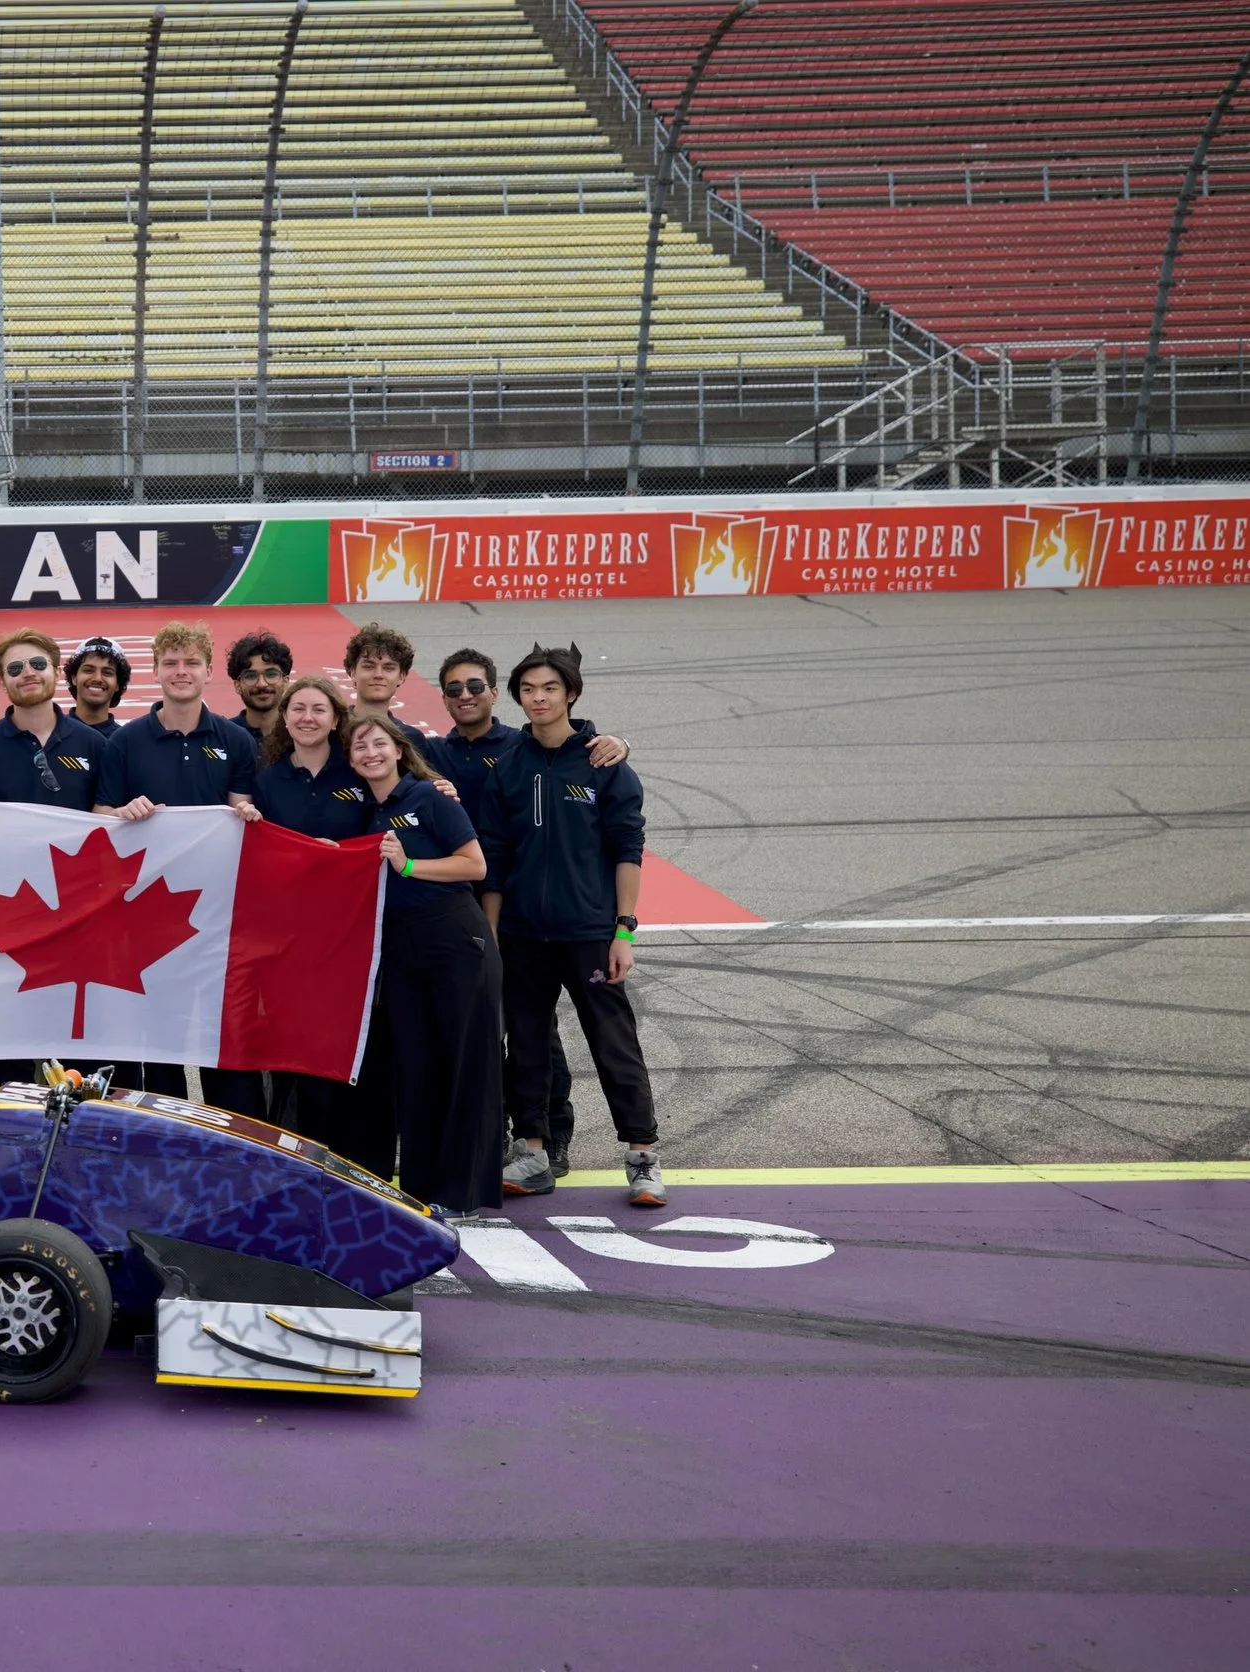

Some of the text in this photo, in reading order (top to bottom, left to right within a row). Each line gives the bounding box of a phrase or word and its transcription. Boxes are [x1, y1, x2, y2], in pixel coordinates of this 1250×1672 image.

[376, 455, 445, 467] SECTION 2
[801, 565, 958, 580] CASINO HOTEL
[1135, 559, 1214, 573] CASINO
[473, 572, 628, 587] CASINO HOTEL
[1157, 575, 1212, 585] BATTLE
[823, 580, 934, 593] BATTLE CREEK
[495, 588, 604, 599] BATTLE CREEK
